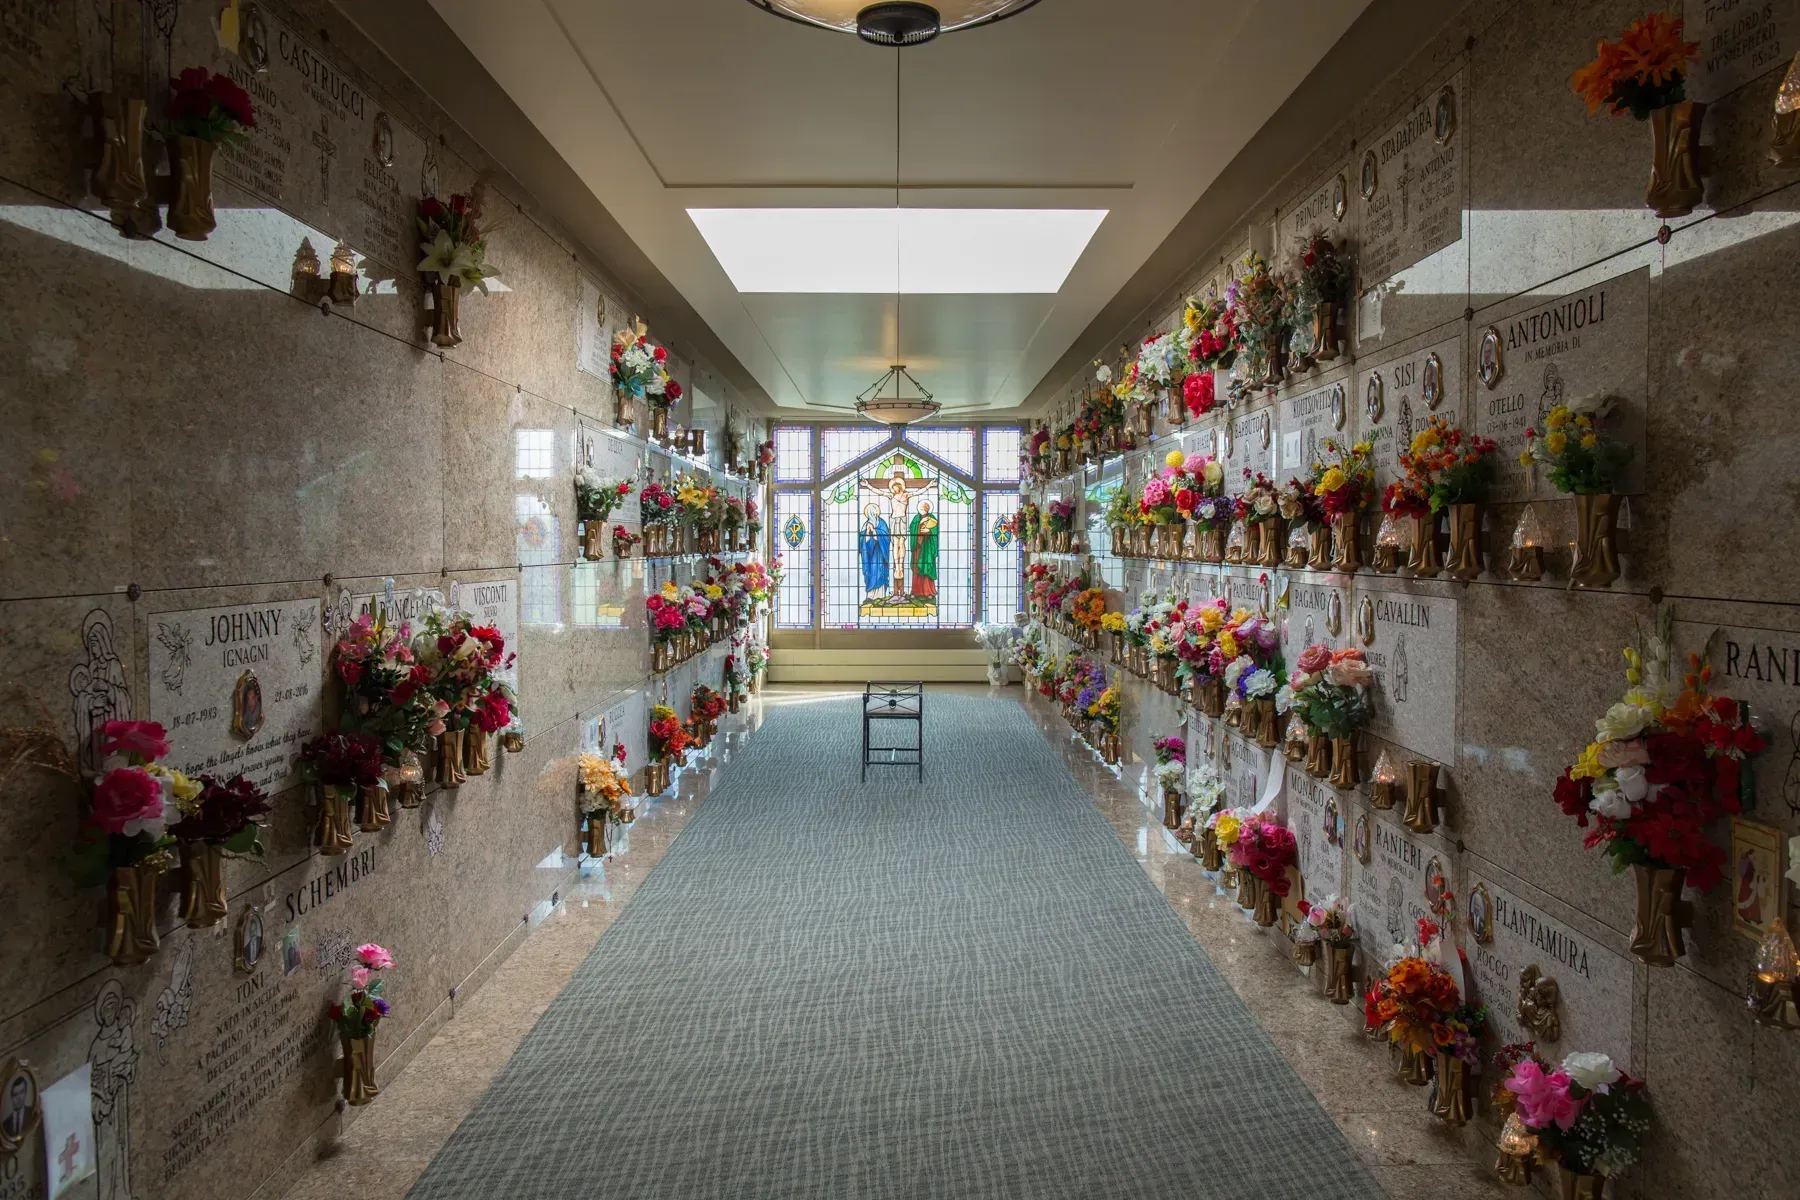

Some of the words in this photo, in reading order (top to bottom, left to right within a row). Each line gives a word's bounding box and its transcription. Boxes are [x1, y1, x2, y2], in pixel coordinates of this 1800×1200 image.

[1712, 28, 1728, 52] THE
[1733, 11, 1759, 40] LORD
[1763, 2, 1773, 20] IS
[1707, 55, 1720, 76] MY
[1724, 22, 1775, 67] SHEPHERD
[228, 64, 276, 108] ANTONIO
[280, 31, 364, 121] CASTRUCCI
[1381, 107, 1432, 166] SPADAFORA
[364, 157, 400, 195] FELICETTA
[1419, 146, 1454, 182] ANTONIO
[1295, 189, 1329, 232] PRINCIPE
[1366, 191, 1390, 219] ANGELA
[1507, 291, 1605, 350] ANTONIOLI
[1525, 349, 1533, 363] IN
[1535, 341, 1569, 360] MEMORIA
[1572, 335, 1581, 349] DI
[1395, 361, 1416, 390] SISI
[1489, 393, 1525, 417] OTELLO
[1235, 416, 1260, 439] BARBUTO
[474, 585, 507, 606] VISCONTI
[1233, 582, 1260, 602] PANTALEO
[1294, 589, 1326, 611] PAGANO
[205, 609, 282, 646] JOHNNY
[1376, 600, 1430, 628] CAVALLIN
[223, 644, 269, 668] IGNAGNI
[207, 754, 218, 768] the
[246, 742, 265, 756] know
[265, 735, 281, 750] what
[1291, 771, 1324, 808] MONACO
[1376, 823, 1421, 871] RANIERI
[286, 846, 375, 924] SCHEMBRI
[1362, 869, 1378, 891] LUIGI
[1495, 896, 1590, 979] PLANTAMURA
[1477, 946, 1509, 981] ROCCO
[236, 971, 264, 1003] TONI
[216, 1012, 240, 1037] NATO
[206, 1029, 243, 1065] PACHINO
[207, 1040, 252, 1082] DECEDUTO
